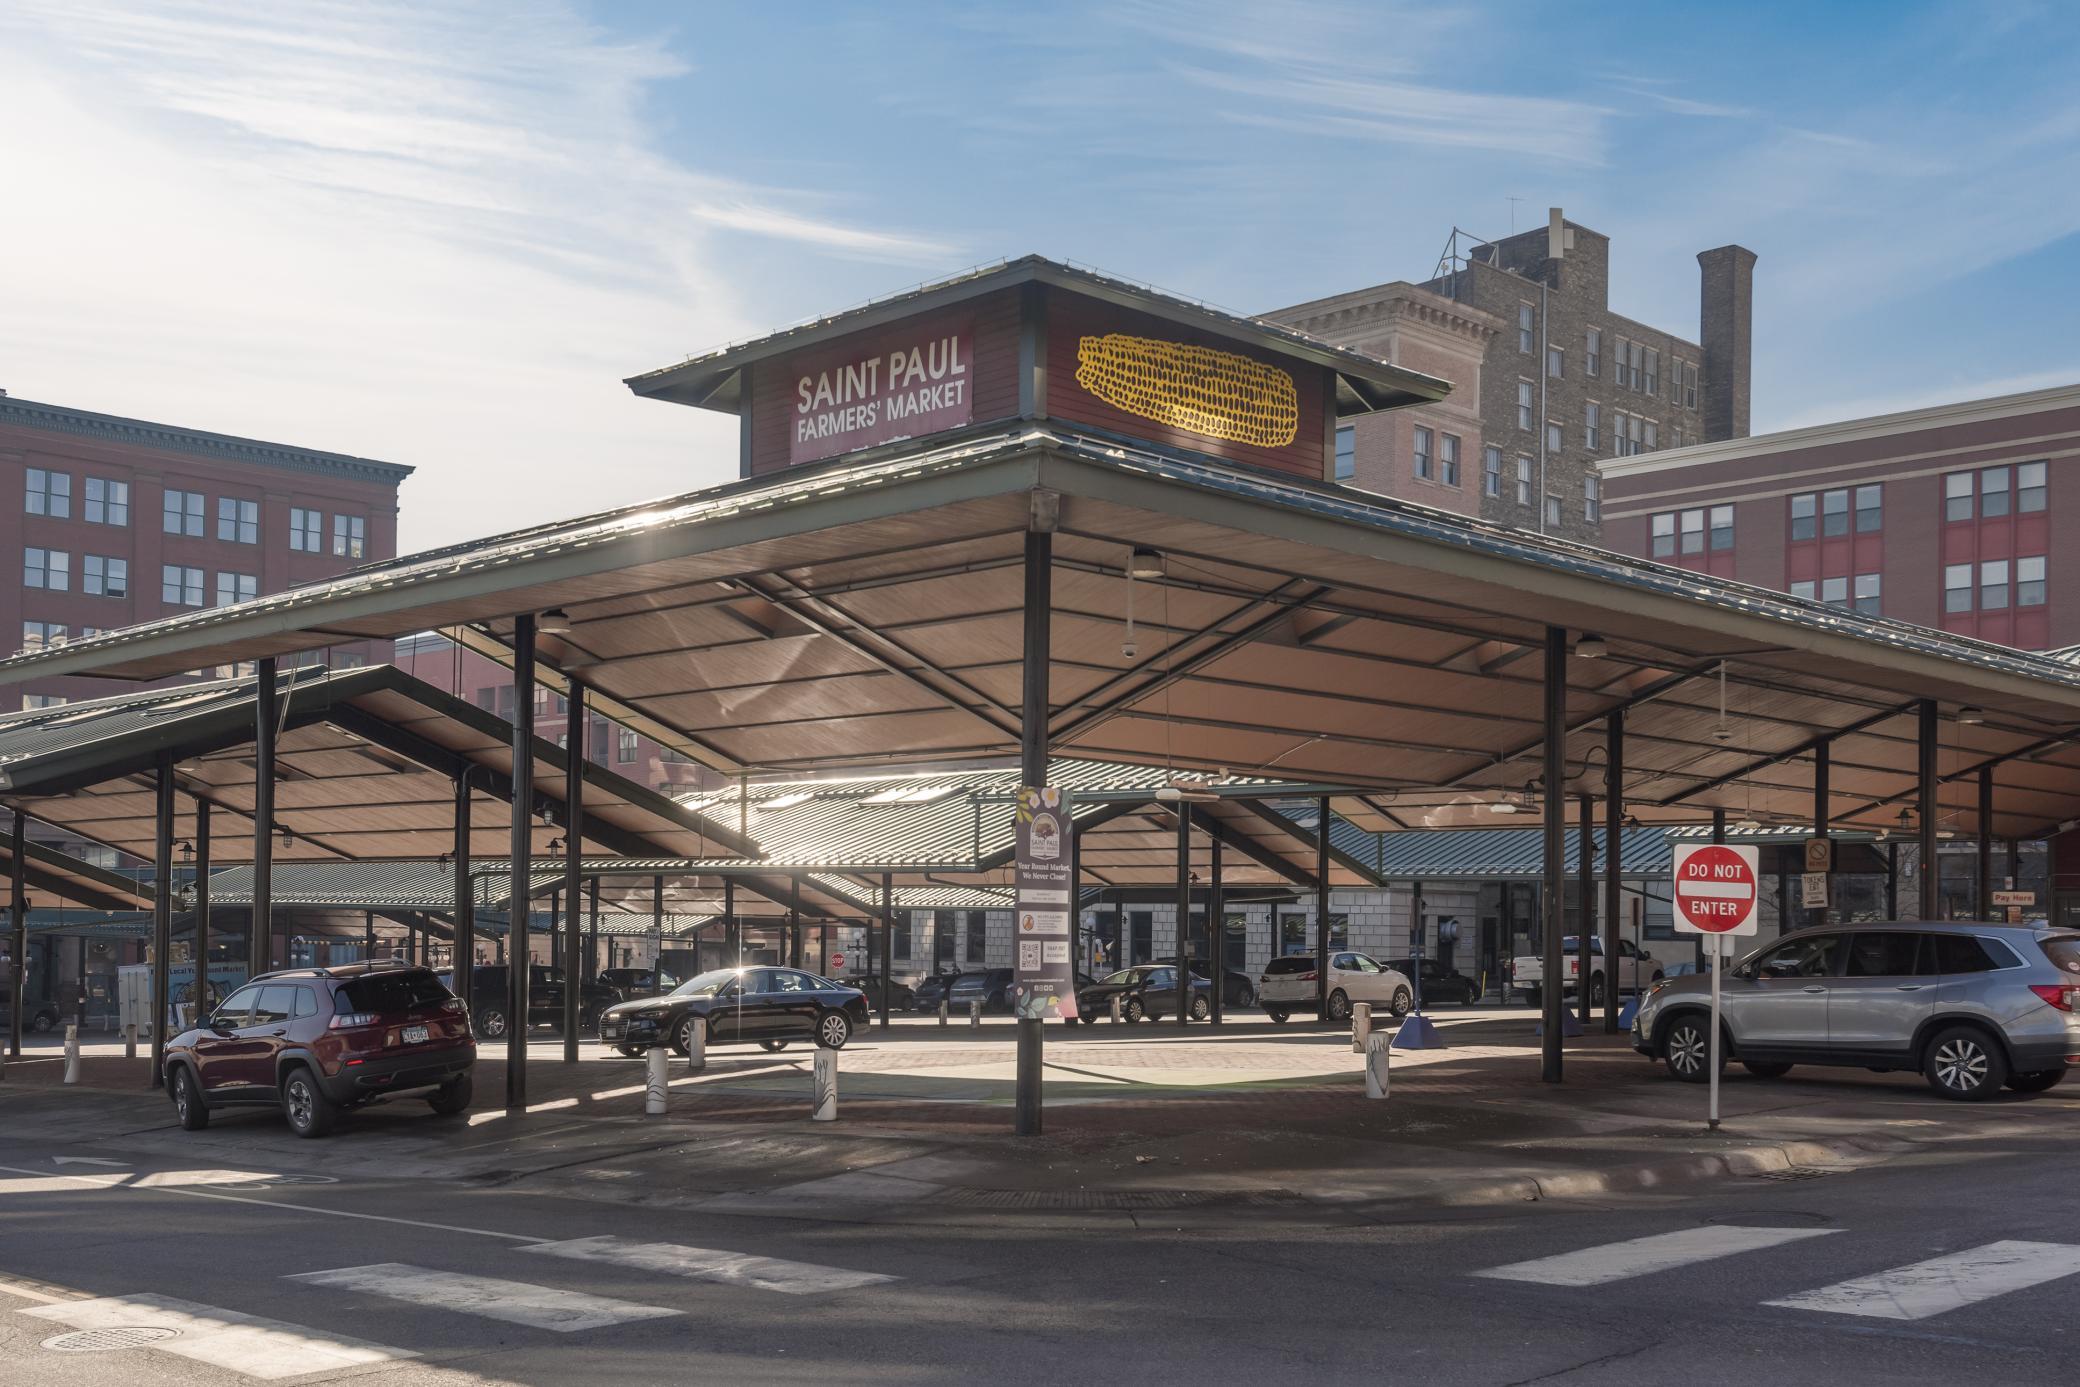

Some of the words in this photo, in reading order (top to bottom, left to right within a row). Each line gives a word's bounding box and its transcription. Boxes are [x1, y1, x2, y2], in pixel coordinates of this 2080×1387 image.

[797, 357, 881, 414] SAINT
[889, 336, 966, 390] PAUL
[798, 400, 880, 442] FARMERS'
[887, 379, 965, 421] MARKET
[1018, 862, 1031, 870] Year
[1689, 863, 1708, 877] DO
[1714, 864, 1743, 878] NOT
[1022, 871, 1031, 880] We
[1032, 872, 1049, 880] Never
[1803, 875, 1825, 884] TOKENS
[1995, 894, 2010, 902] Pay
[1691, 901, 1737, 916] ENTER
[169, 967, 187, 975] Local
